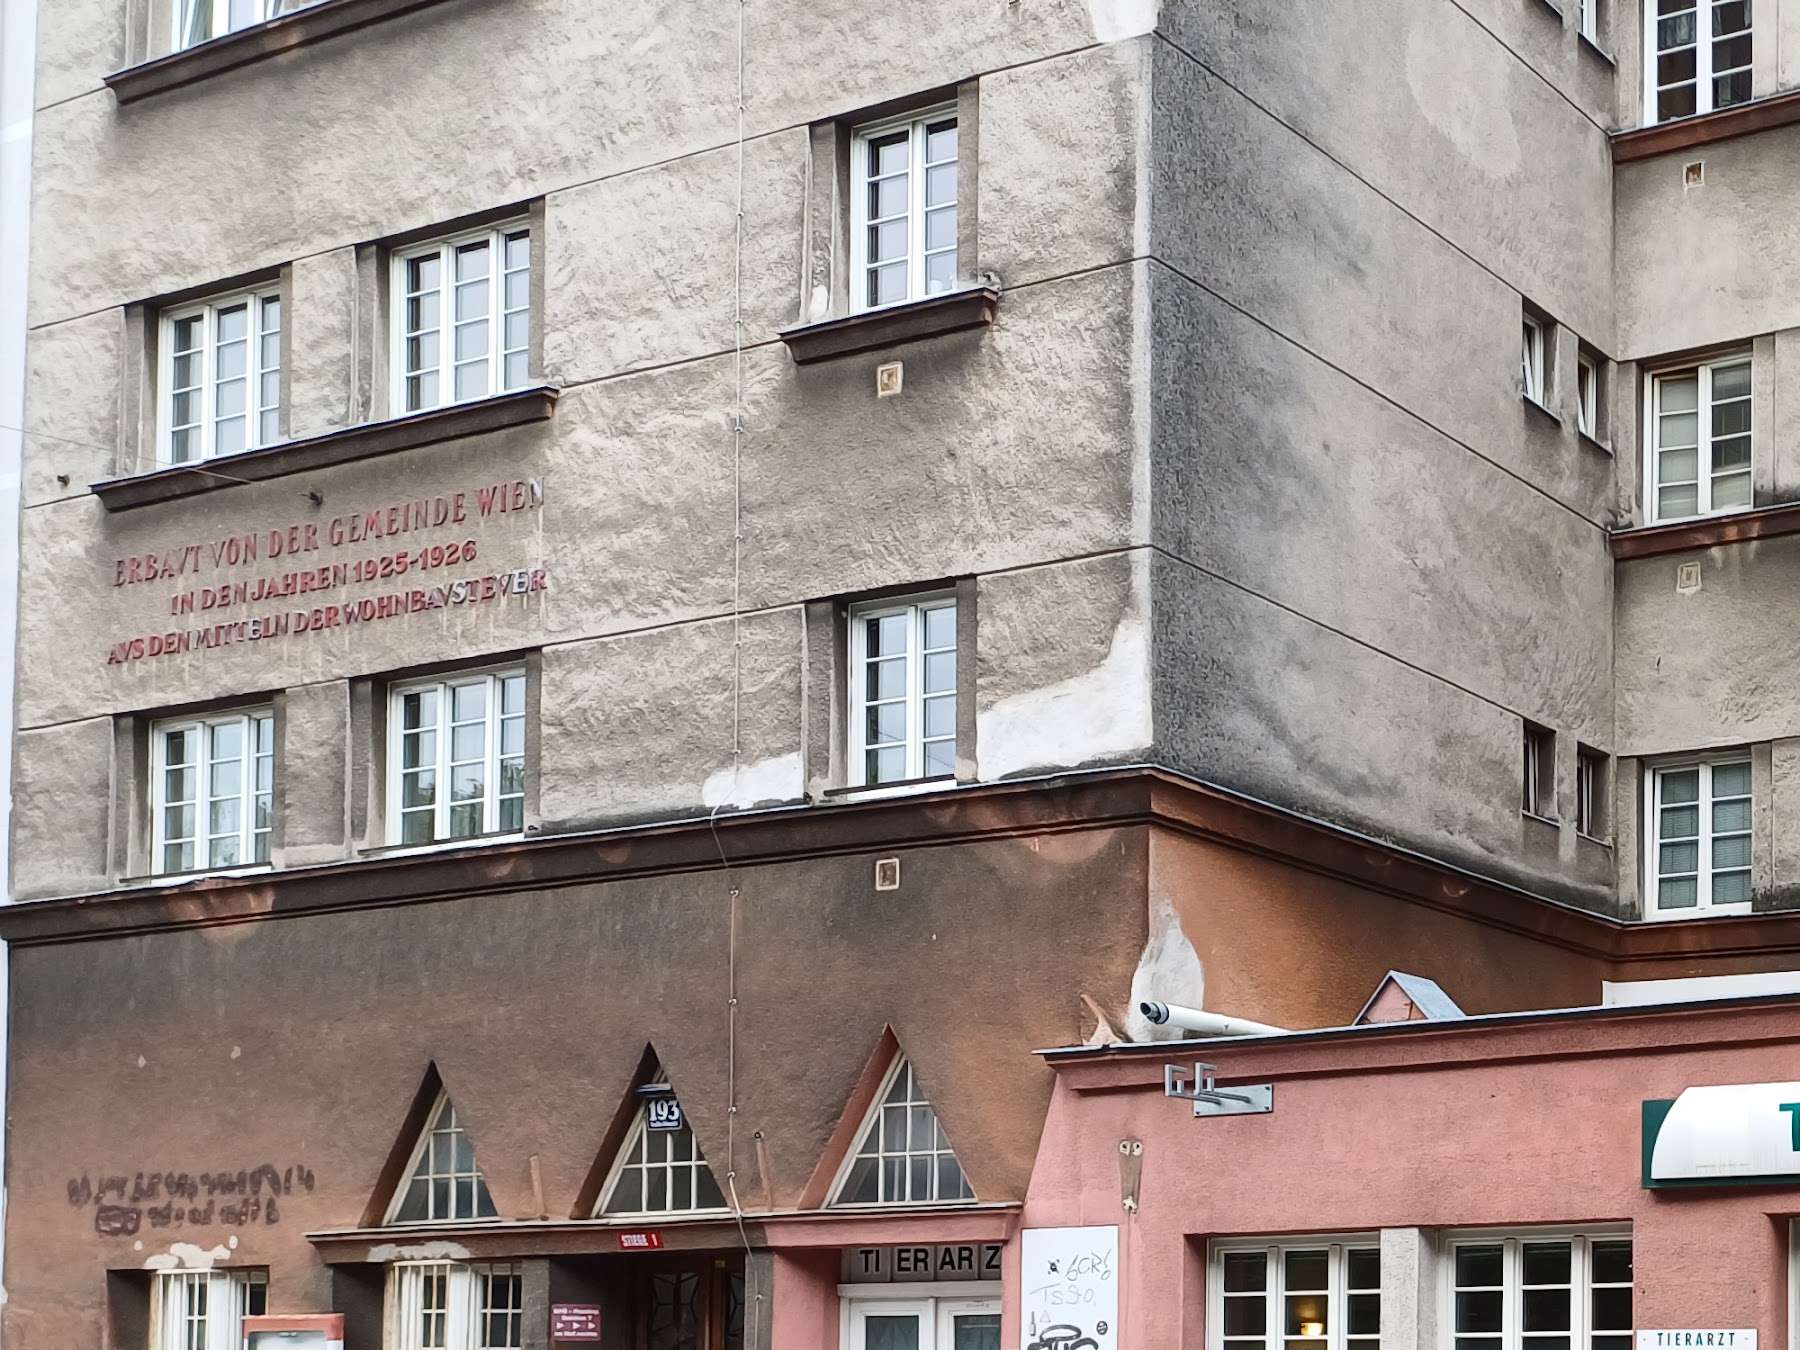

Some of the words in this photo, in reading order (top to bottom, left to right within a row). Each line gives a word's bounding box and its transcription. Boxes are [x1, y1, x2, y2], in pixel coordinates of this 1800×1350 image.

[210, 533, 258, 568] VON
[268, 523, 319, 558] DER
[328, 493, 466, 546] GEMEINDE
[474, 476, 545, 517] WIEN
[171, 591, 194, 616] IN
[201, 581, 248, 611] DEN
[251, 562, 348, 601] JAHREN
[353, 540, 478, 583] 1925-1926
[148, 631, 190, 657] DEN
[193, 613, 289, 650] MITTELN
[293, 605, 341, 634] DER
[649, 1100, 680, 1121] 193
[859, 1245, 1001, 1273] TIERARZ
[1657, 1332, 1735, 1346] TIERARZT
